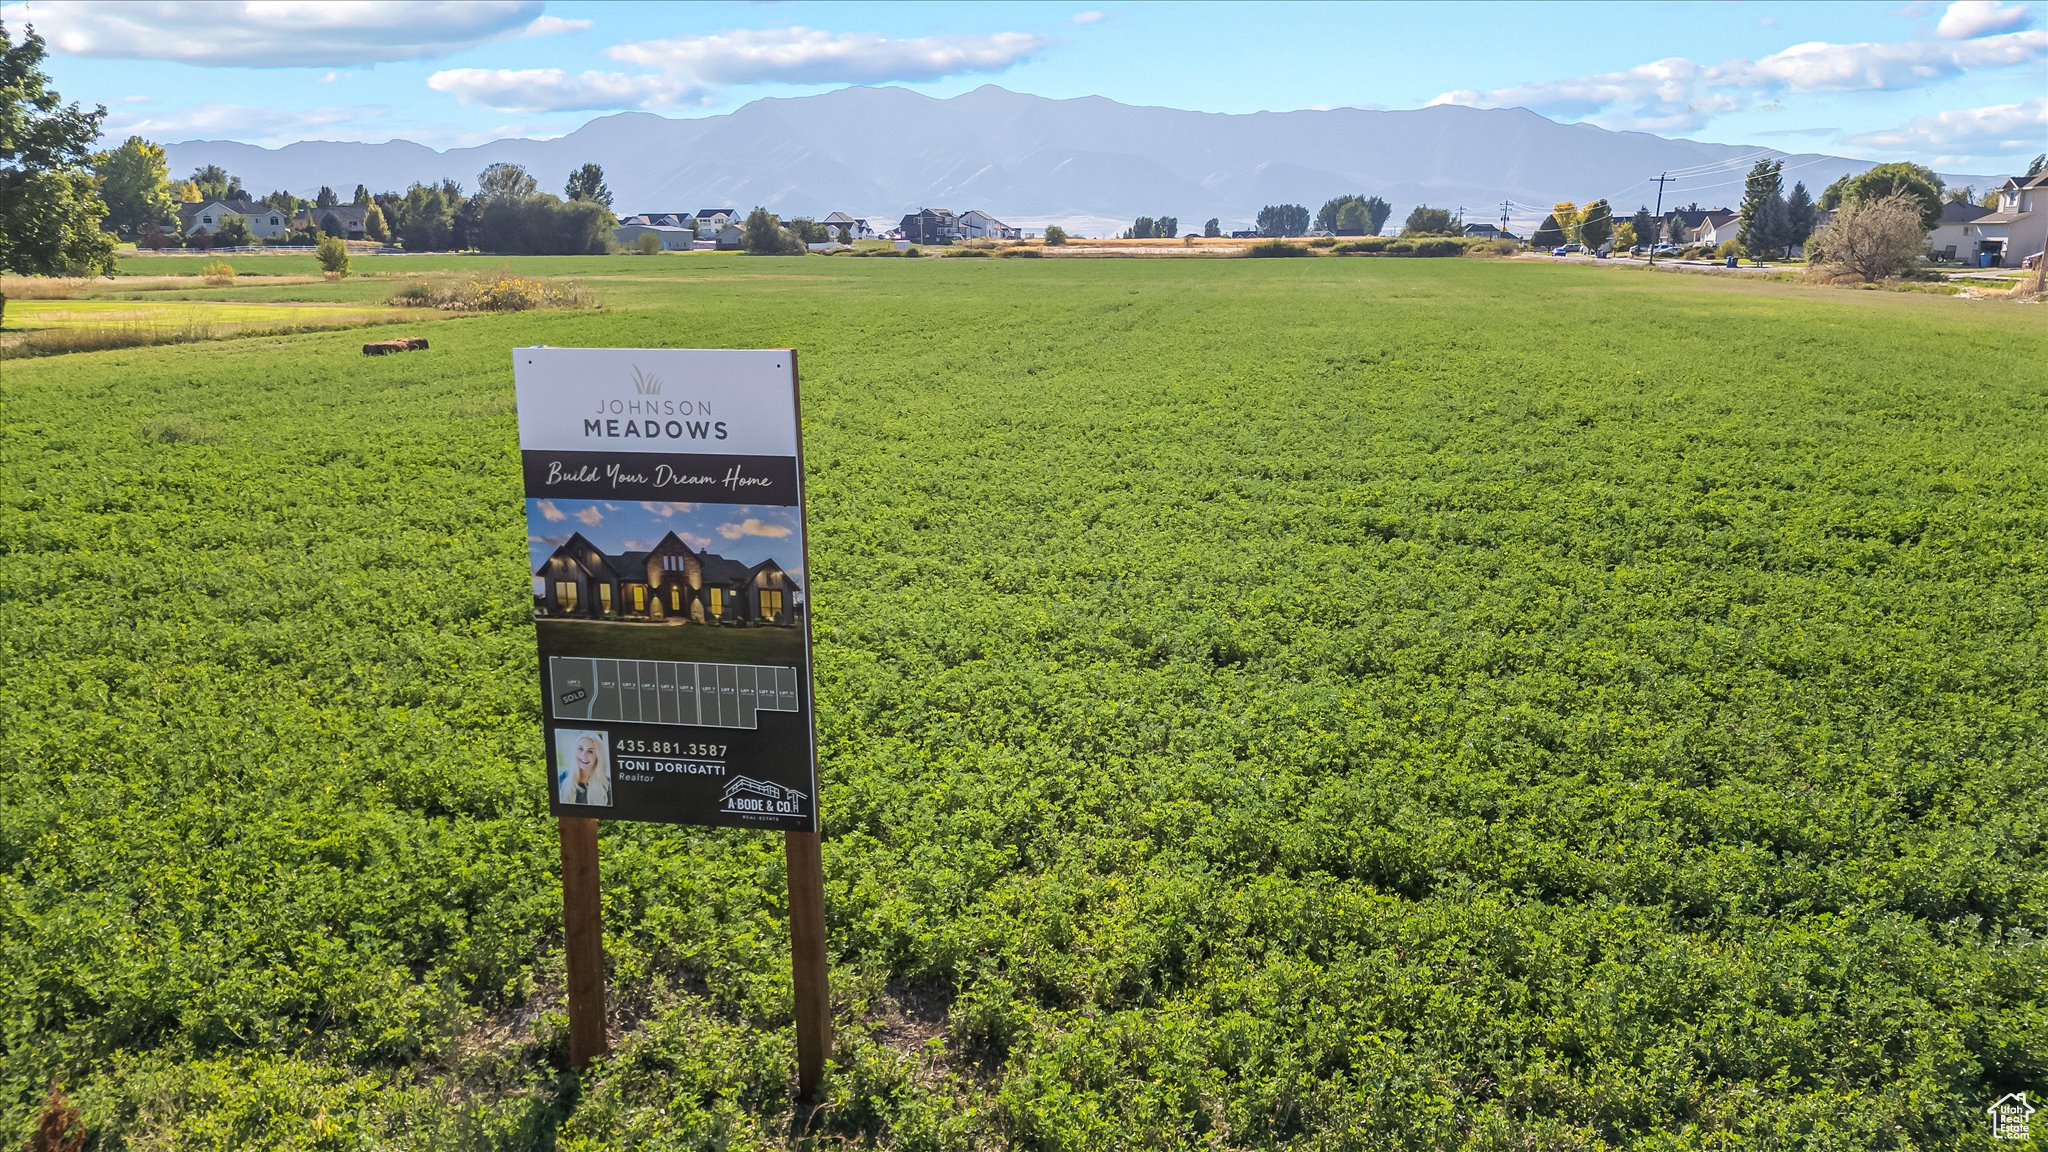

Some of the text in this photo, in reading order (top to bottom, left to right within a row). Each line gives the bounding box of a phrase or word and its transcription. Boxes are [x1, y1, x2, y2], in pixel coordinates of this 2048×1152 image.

[596, 400, 712, 415] JOHNSON
[584, 418, 728, 440] MEADOWS
[546, 461, 772, 491] Build Your Dream Home
[562, 690, 585, 703] SOLD
[617, 740, 727, 756] 435.881.3587
[618, 760, 725, 775] TONI DORIGATTI
[619, 773, 654, 782] Realtor
[767, 800, 774, 811] &
[777, 801, 793, 812] CO.
